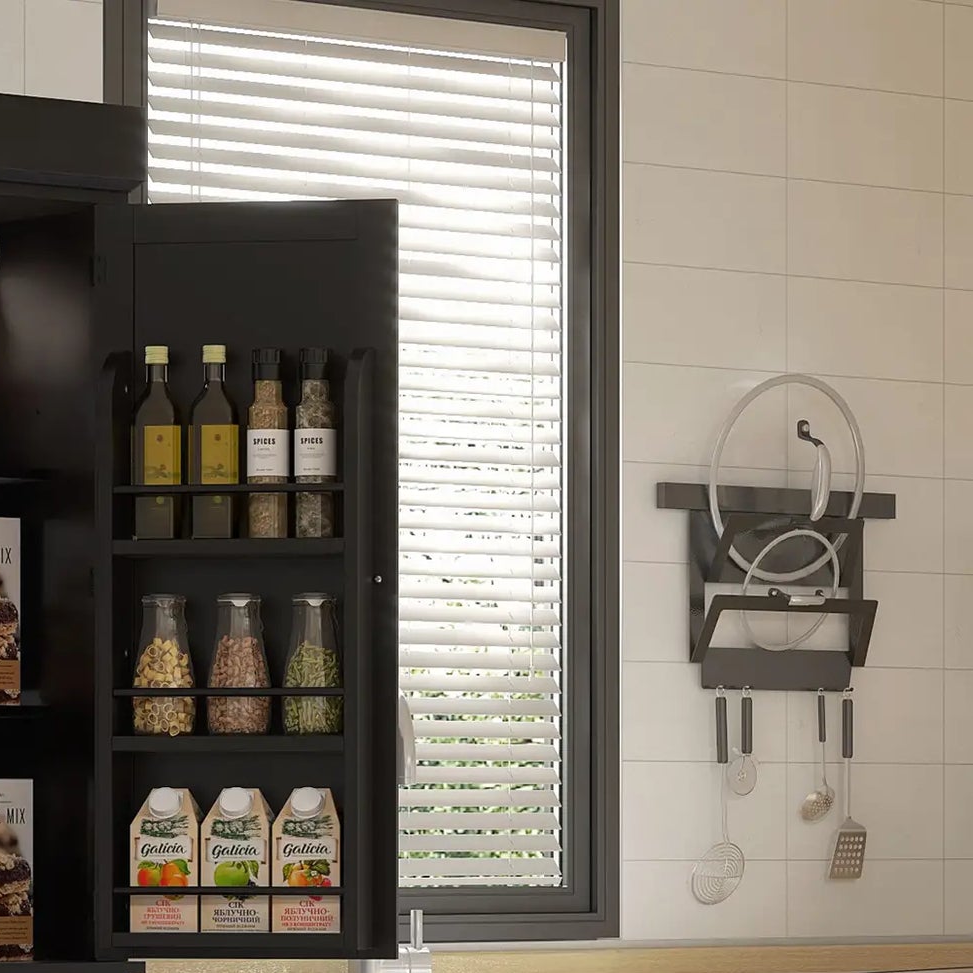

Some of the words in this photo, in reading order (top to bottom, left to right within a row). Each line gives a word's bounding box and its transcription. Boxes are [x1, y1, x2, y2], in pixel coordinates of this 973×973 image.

[300, 437, 323, 445] SPICES
[6, 808, 26, 824] MIX
[141, 842, 187, 858] Galicia
[211, 844, 260, 859] Galicia
[283, 842, 331, 858] Galicia
